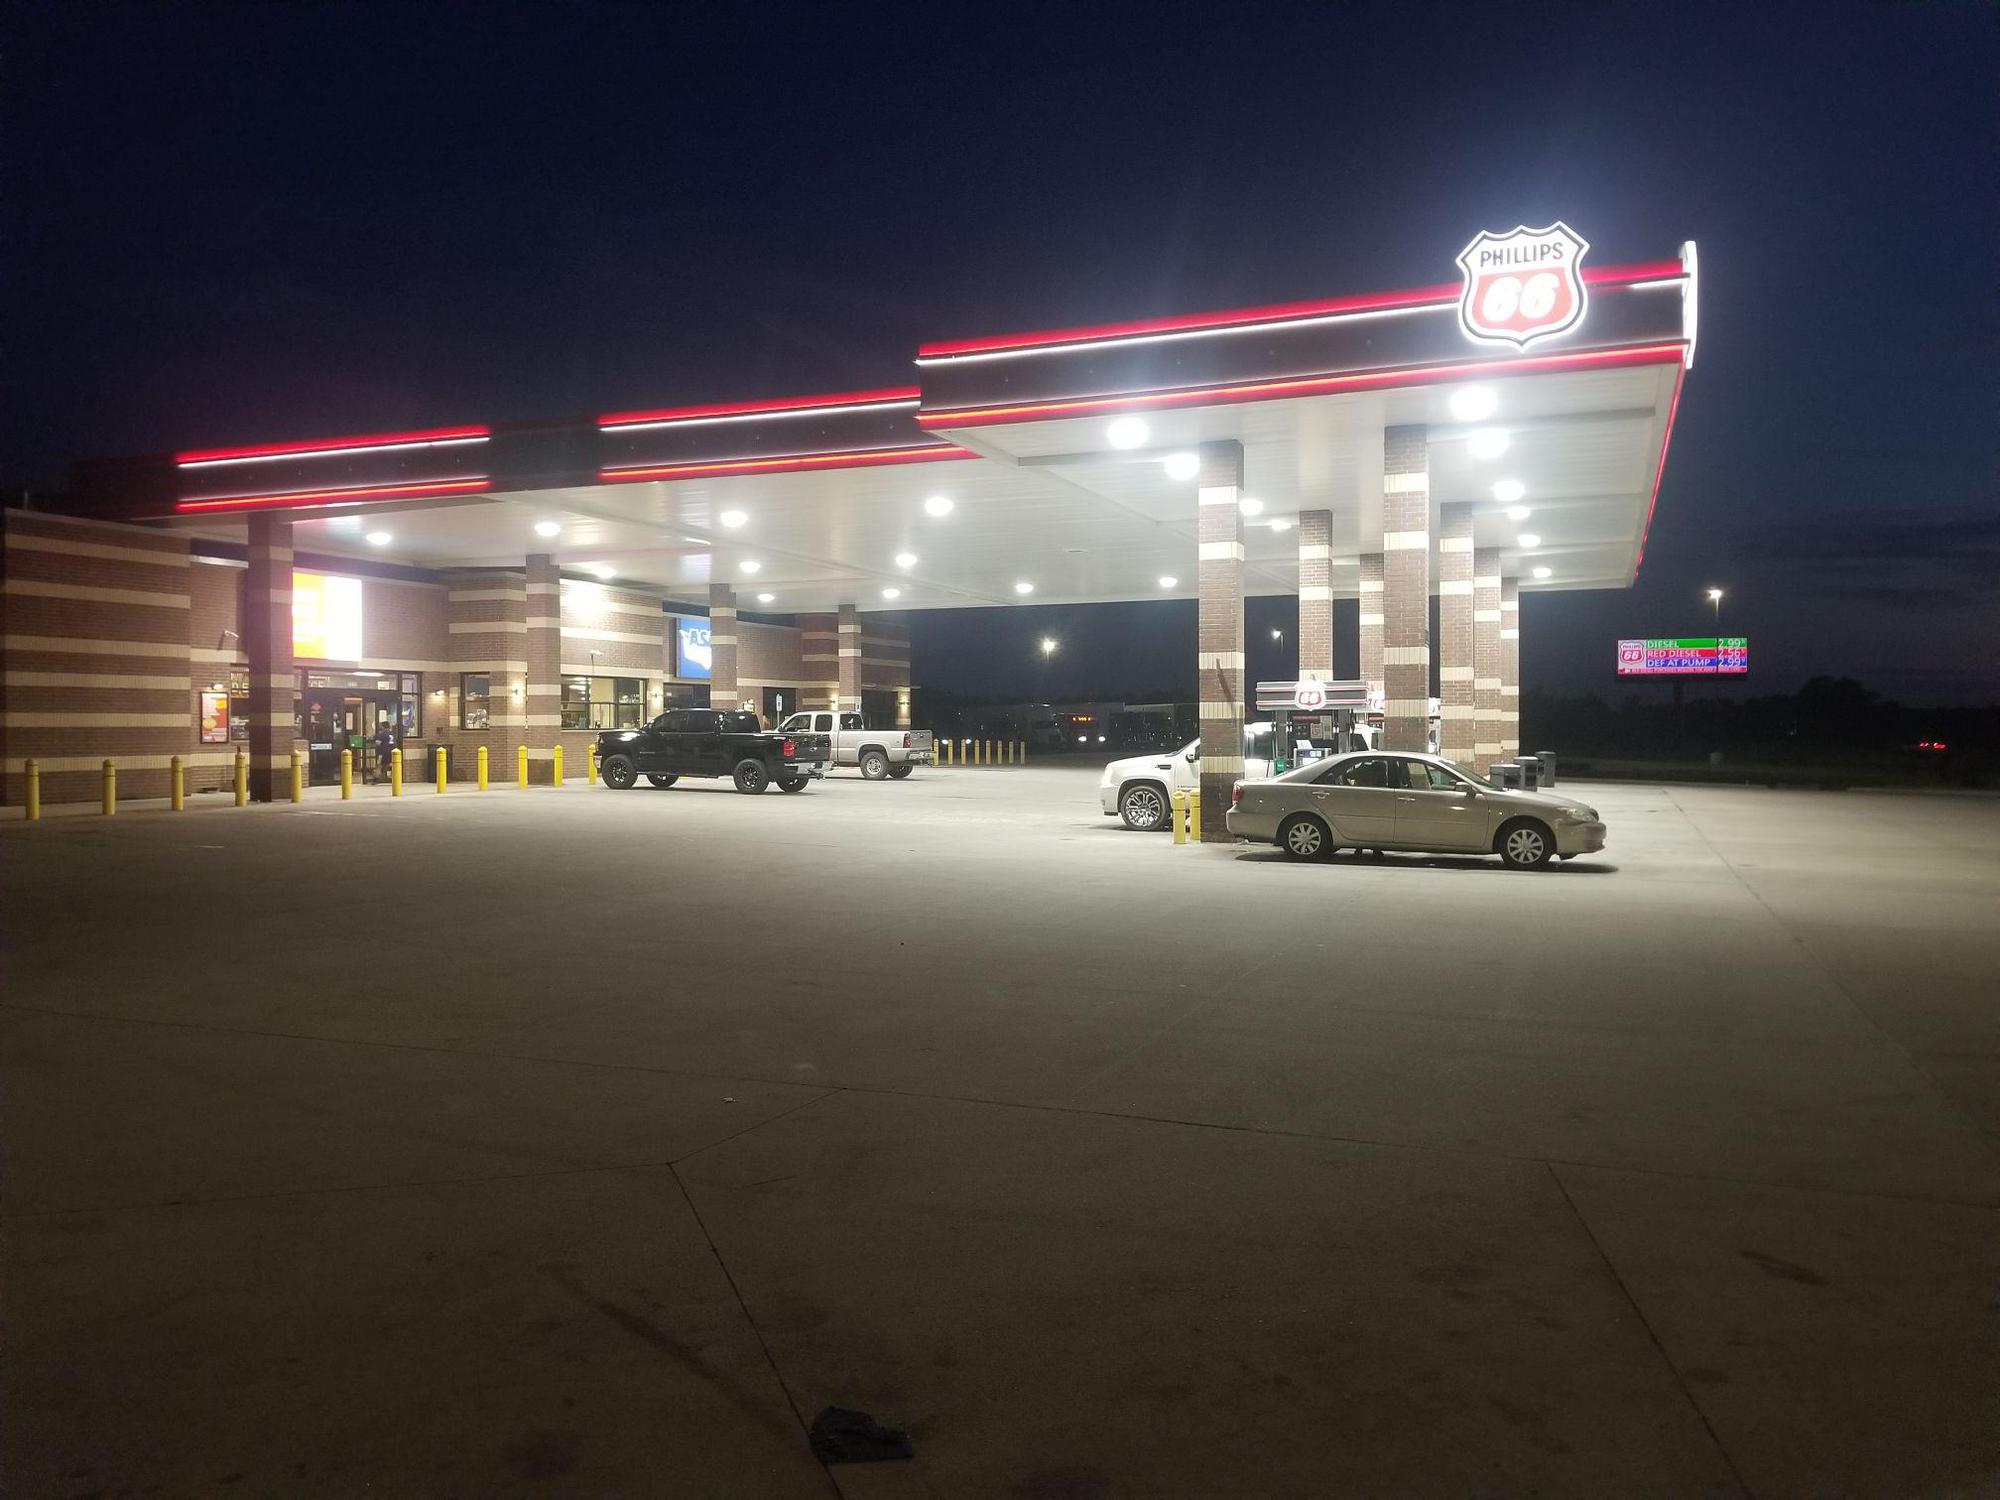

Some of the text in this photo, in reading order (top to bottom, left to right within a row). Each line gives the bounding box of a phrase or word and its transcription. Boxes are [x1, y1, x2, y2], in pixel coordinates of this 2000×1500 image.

[1479, 241, 1564, 268] PHILLIPS
[1481, 272, 1560, 322] 66
[1647, 639, 1679, 648] DIESEL
[1623, 650, 1640, 660] 66
[1647, 649, 1701, 658] RED DIESEL
[1647, 658, 1710, 667] DEF AT PUMP
